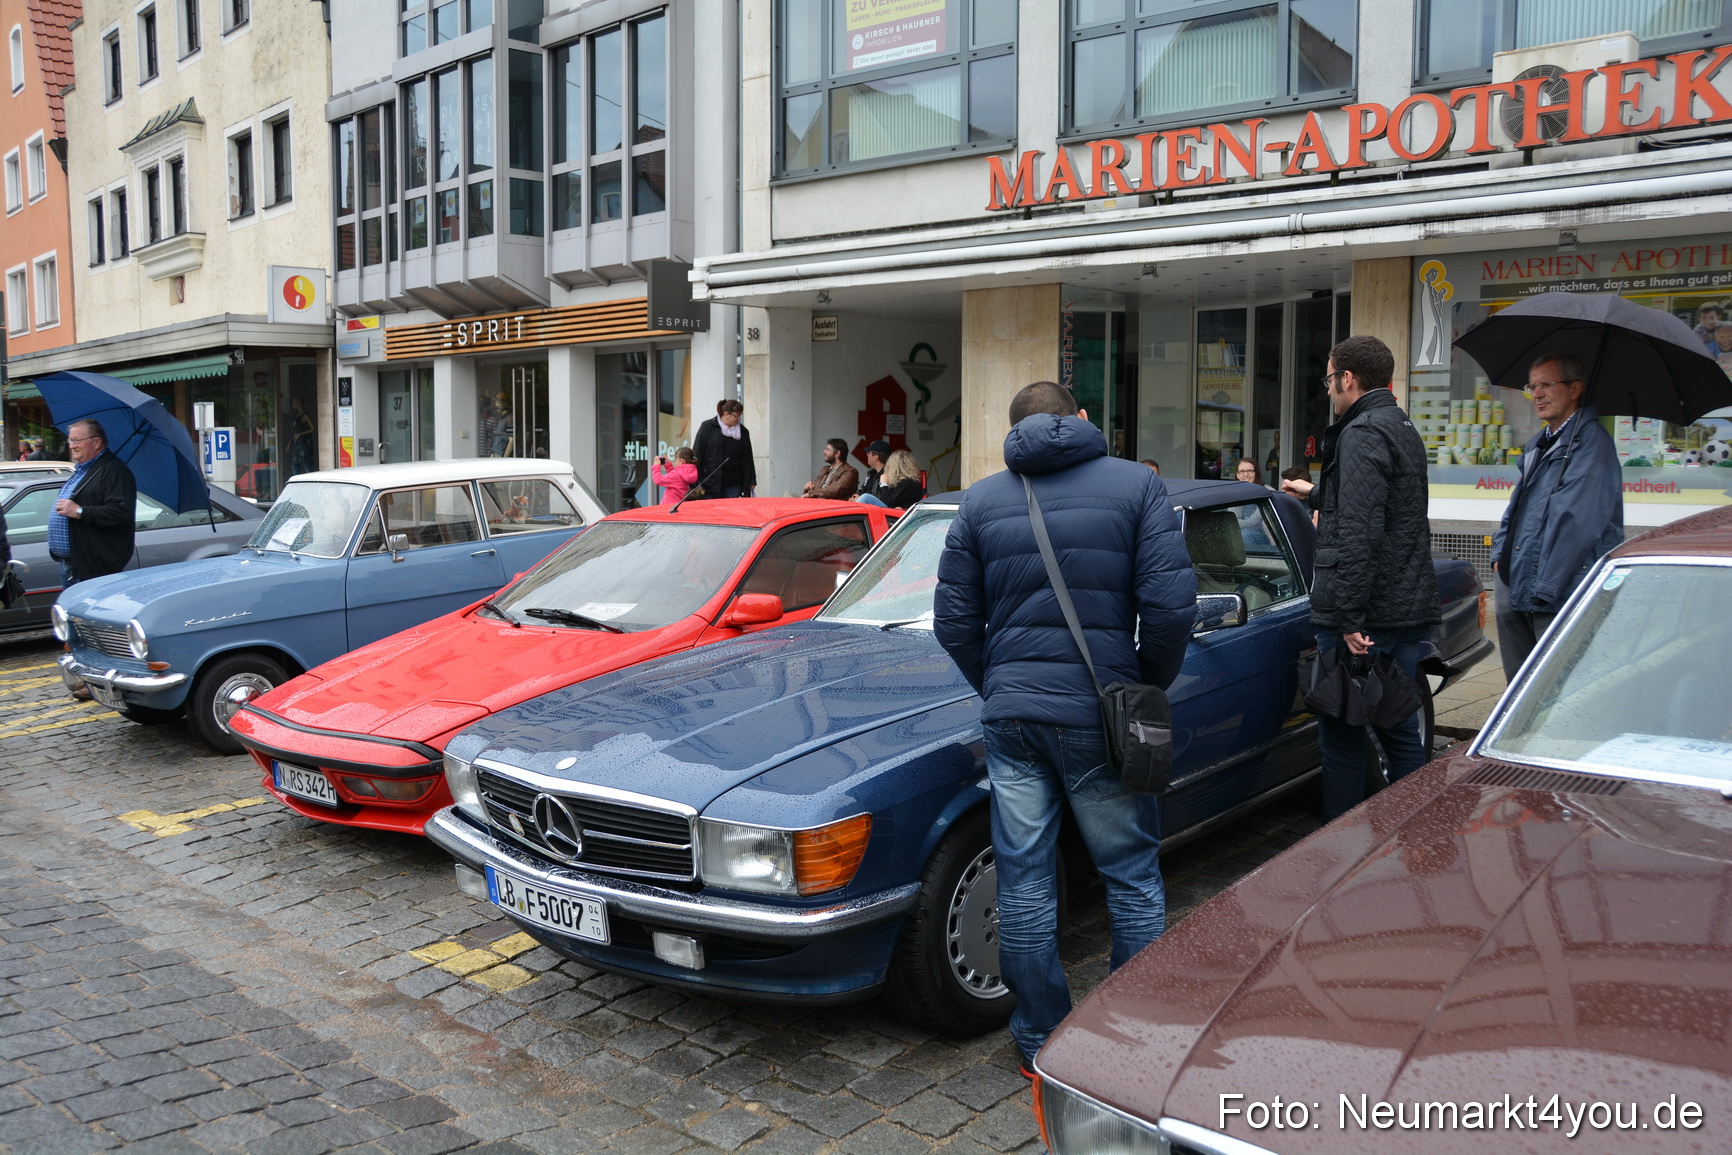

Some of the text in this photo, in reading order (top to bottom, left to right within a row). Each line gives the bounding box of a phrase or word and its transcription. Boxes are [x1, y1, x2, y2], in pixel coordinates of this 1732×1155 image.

[851, 0, 866, 13] ZU
[851, 14, 870, 22] LADEN
[875, 8, 891, 17] BÜRO
[865, 15, 941, 39] KIRSCH & HAUBNER
[865, 34, 902, 48] IMMOBILIEN
[1481, 243, 1732, 281] MARIEN APOTH
[1549, 278, 1600, 294] möchten,
[1633, 279, 1646, 287] es
[1649, 275, 1684, 287] Ihnen
[1687, 274, 1708, 287] gut
[657, 315, 702, 328] ESPRIT
[815, 319, 836, 330] Ausfahrt
[443, 315, 524, 346] ESPRIT
[747, 328, 760, 340] 38
[1063, 299, 1074, 390] MARIEN
[393, 396, 403, 411] 37
[218, 434, 228, 449] P
[1475, 476, 1681, 494] Aktiv ndheit.
[496, 874, 516, 908] LB
[588, 904, 599, 915] 04
[591, 925, 601, 936] 10
